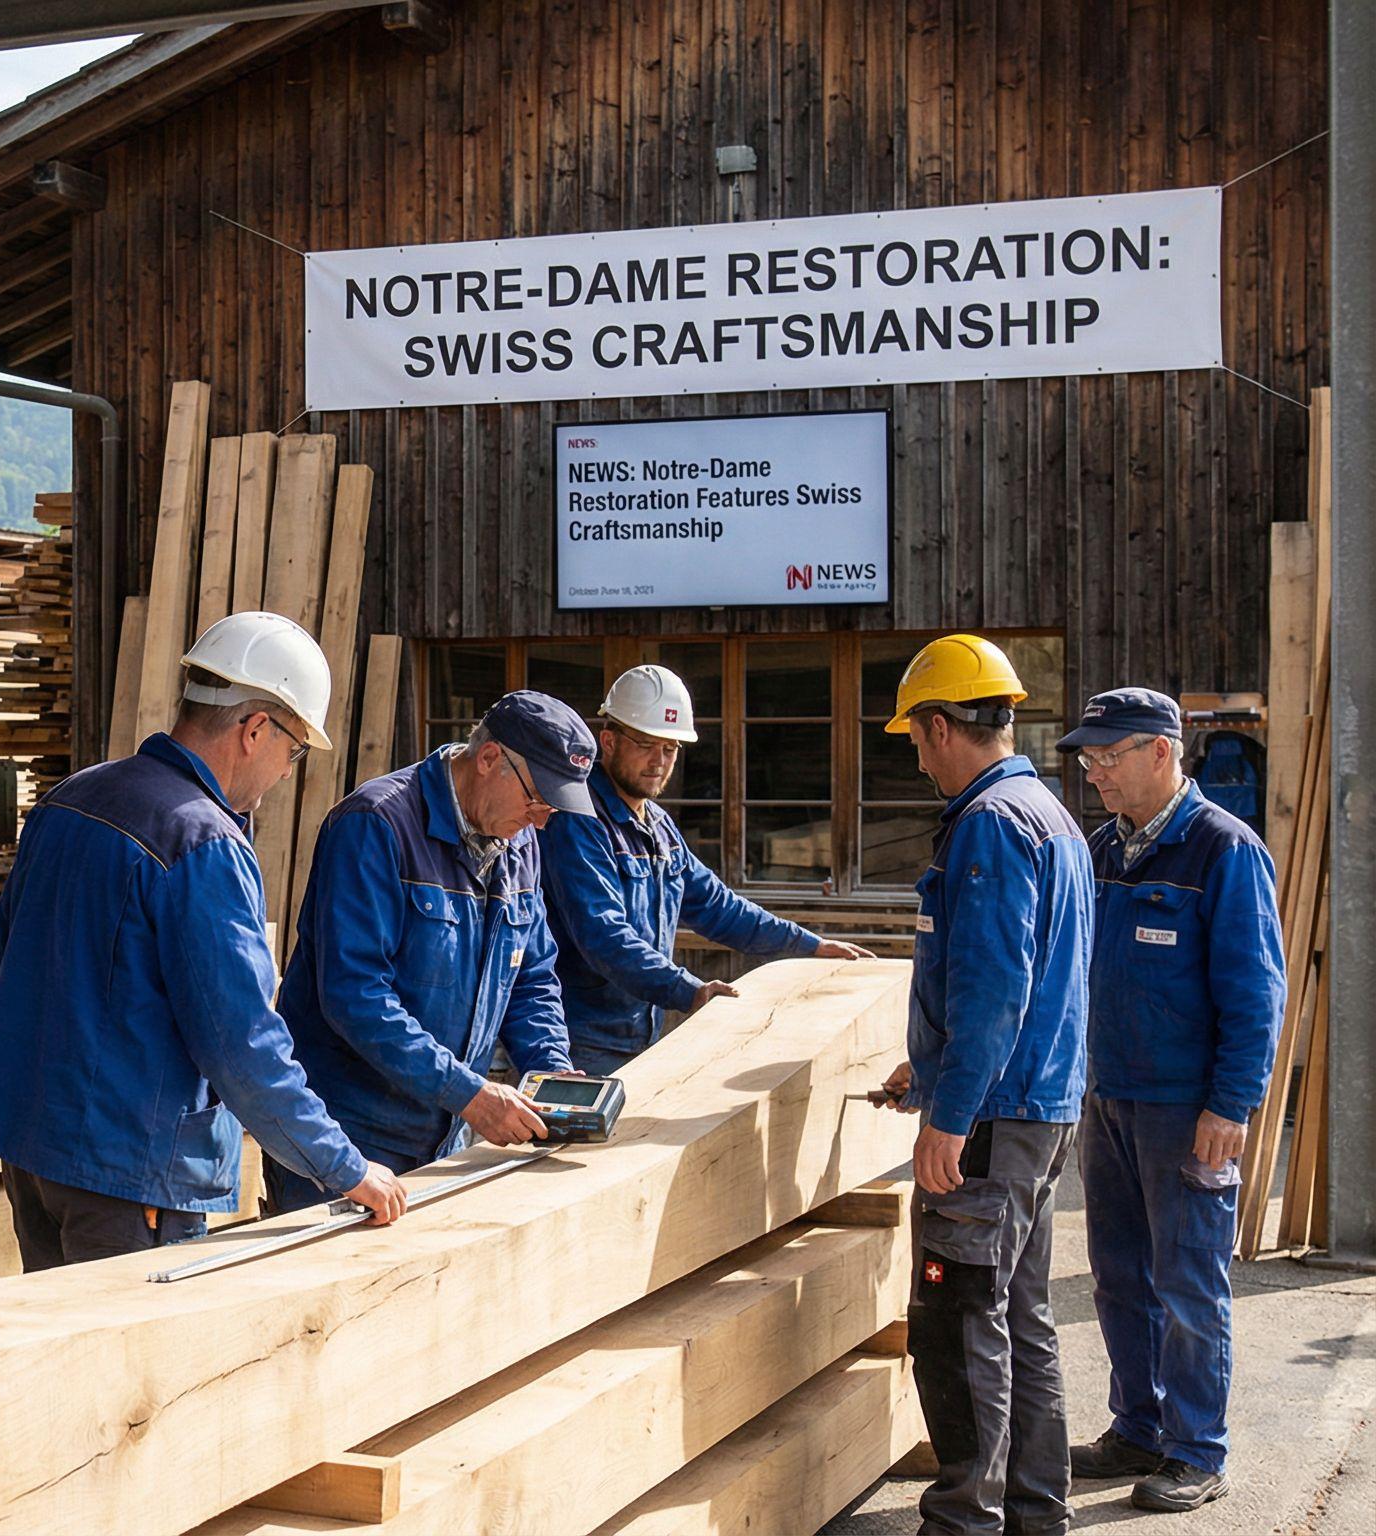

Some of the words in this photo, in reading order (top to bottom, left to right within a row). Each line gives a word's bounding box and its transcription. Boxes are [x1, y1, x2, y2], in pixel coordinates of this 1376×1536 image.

[346, 255, 707, 319] NOTRE-DAME
[728, 226, 1170, 296] RESTORATION:
[405, 329, 573, 377] SWISS
[593, 298, 1100, 368] CRAFTSMANSHIP
[568, 460, 636, 483] NEWS:
[642, 457, 772, 481] Notre-Dame
[568, 488, 690, 512] Restoration
[696, 486, 791, 509] Features
[796, 482, 863, 506] Swiss
[568, 516, 725, 542] Craftsmanship
[817, 563, 877, 581] NEWS
